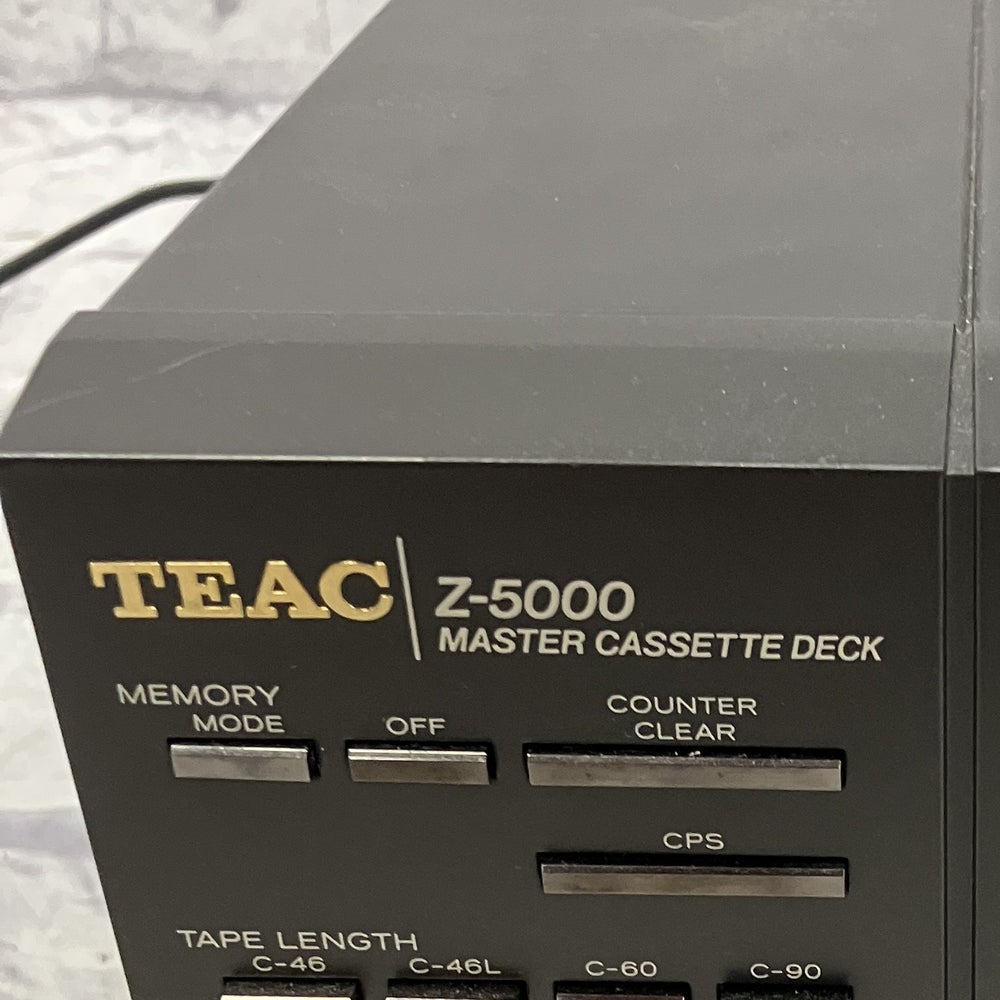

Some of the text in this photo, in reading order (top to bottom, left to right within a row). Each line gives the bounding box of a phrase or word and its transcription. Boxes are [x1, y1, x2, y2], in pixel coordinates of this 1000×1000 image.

[89, 560, 394, 622] TEAC
[435, 576, 636, 622] Z-5000
[438, 627, 885, 662] MASTER CASSETTE DECK
[116, 683, 280, 707] MEMORY
[606, 694, 758, 716] COUNTER
[192, 714, 285, 734] MODE
[384, 716, 447, 736] OFF
[634, 721, 736, 742] CLEAR
[662, 832, 725, 851] CPS
[176, 929, 419, 952] TAPE LENGTH
[252, 956, 327, 973] C-46
[409, 958, 502, 975] C-46L
[585, 961, 658, 978] C-60
[750, 964, 822, 981] C-90
